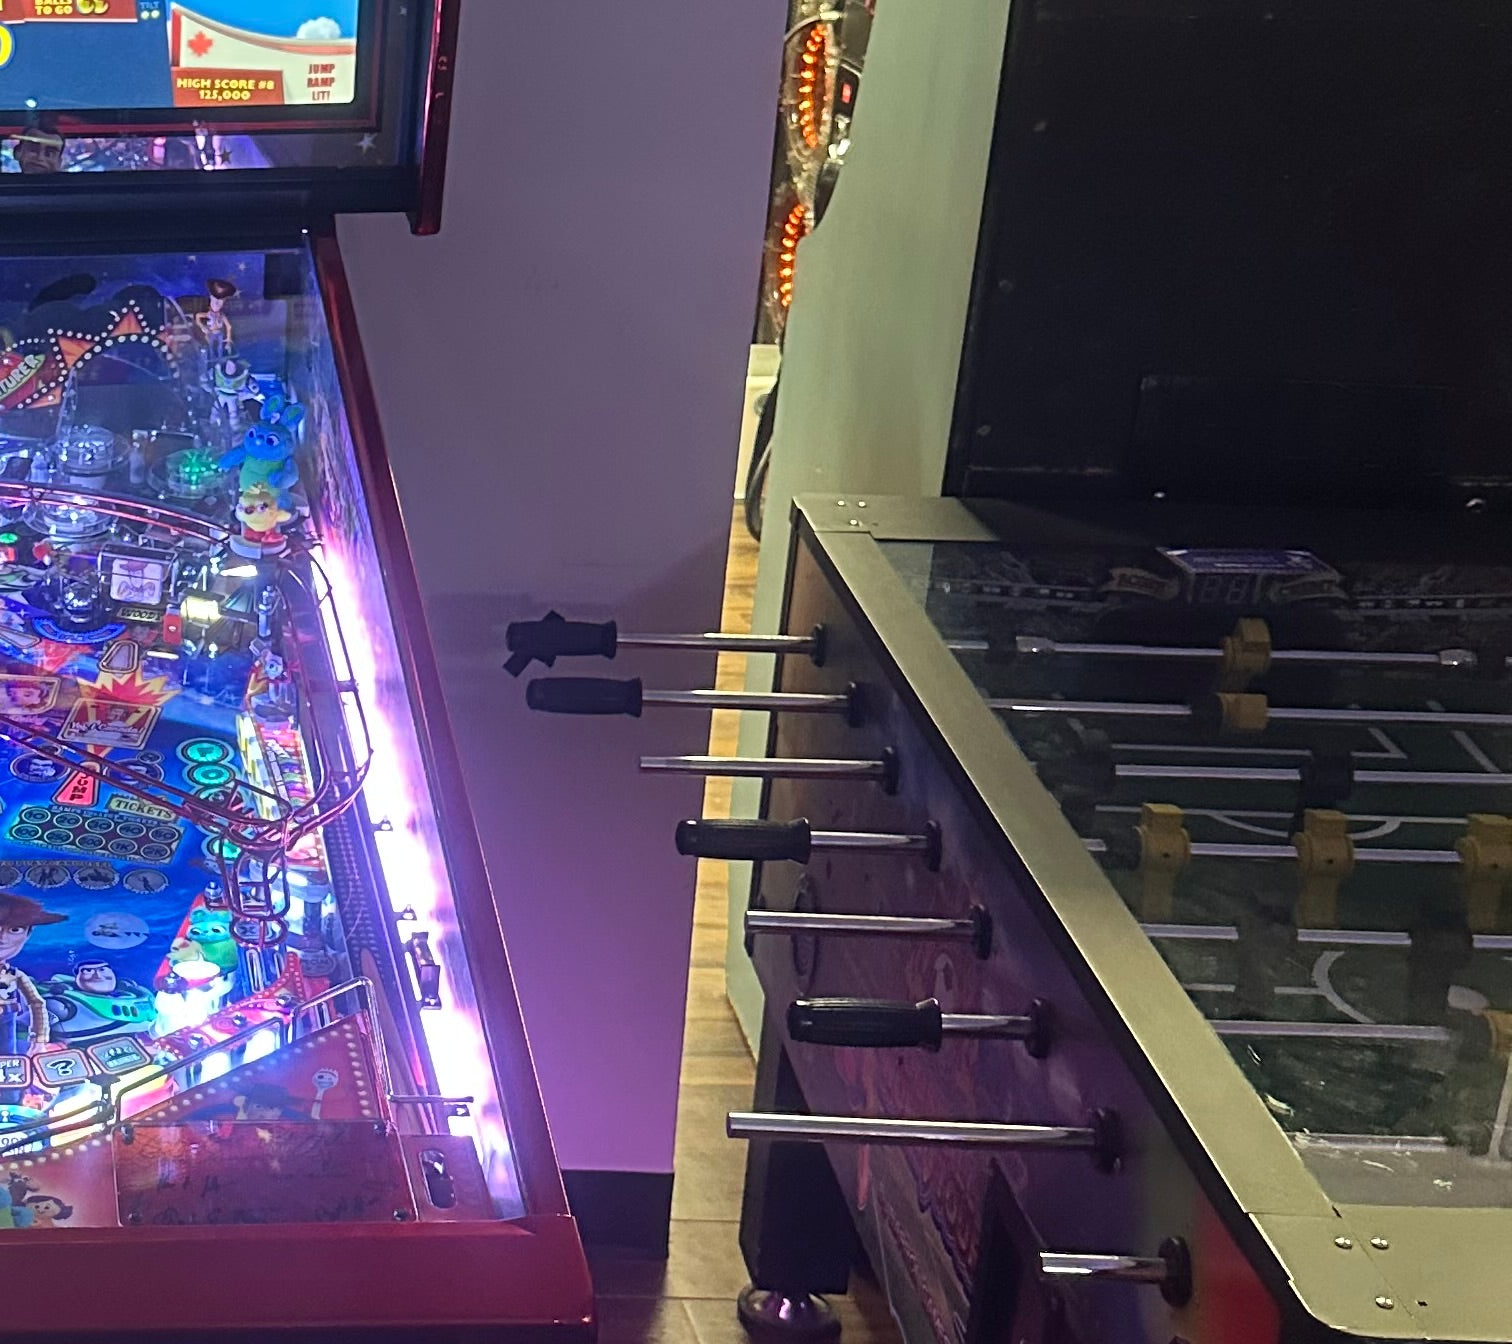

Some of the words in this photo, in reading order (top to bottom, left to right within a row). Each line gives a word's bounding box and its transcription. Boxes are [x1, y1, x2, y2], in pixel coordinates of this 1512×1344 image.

[34, 5, 53, 15] TO
[54, 4, 73, 15] GO
[308, 63, 336, 75] JUMP
[176, 78, 211, 90] HIGH
[214, 78, 256, 90] SCORE
[307, 77, 336, 89] RAMP
[199, 89, 252, 102] 125,000
[114, 798, 175, 820] TICKETS
